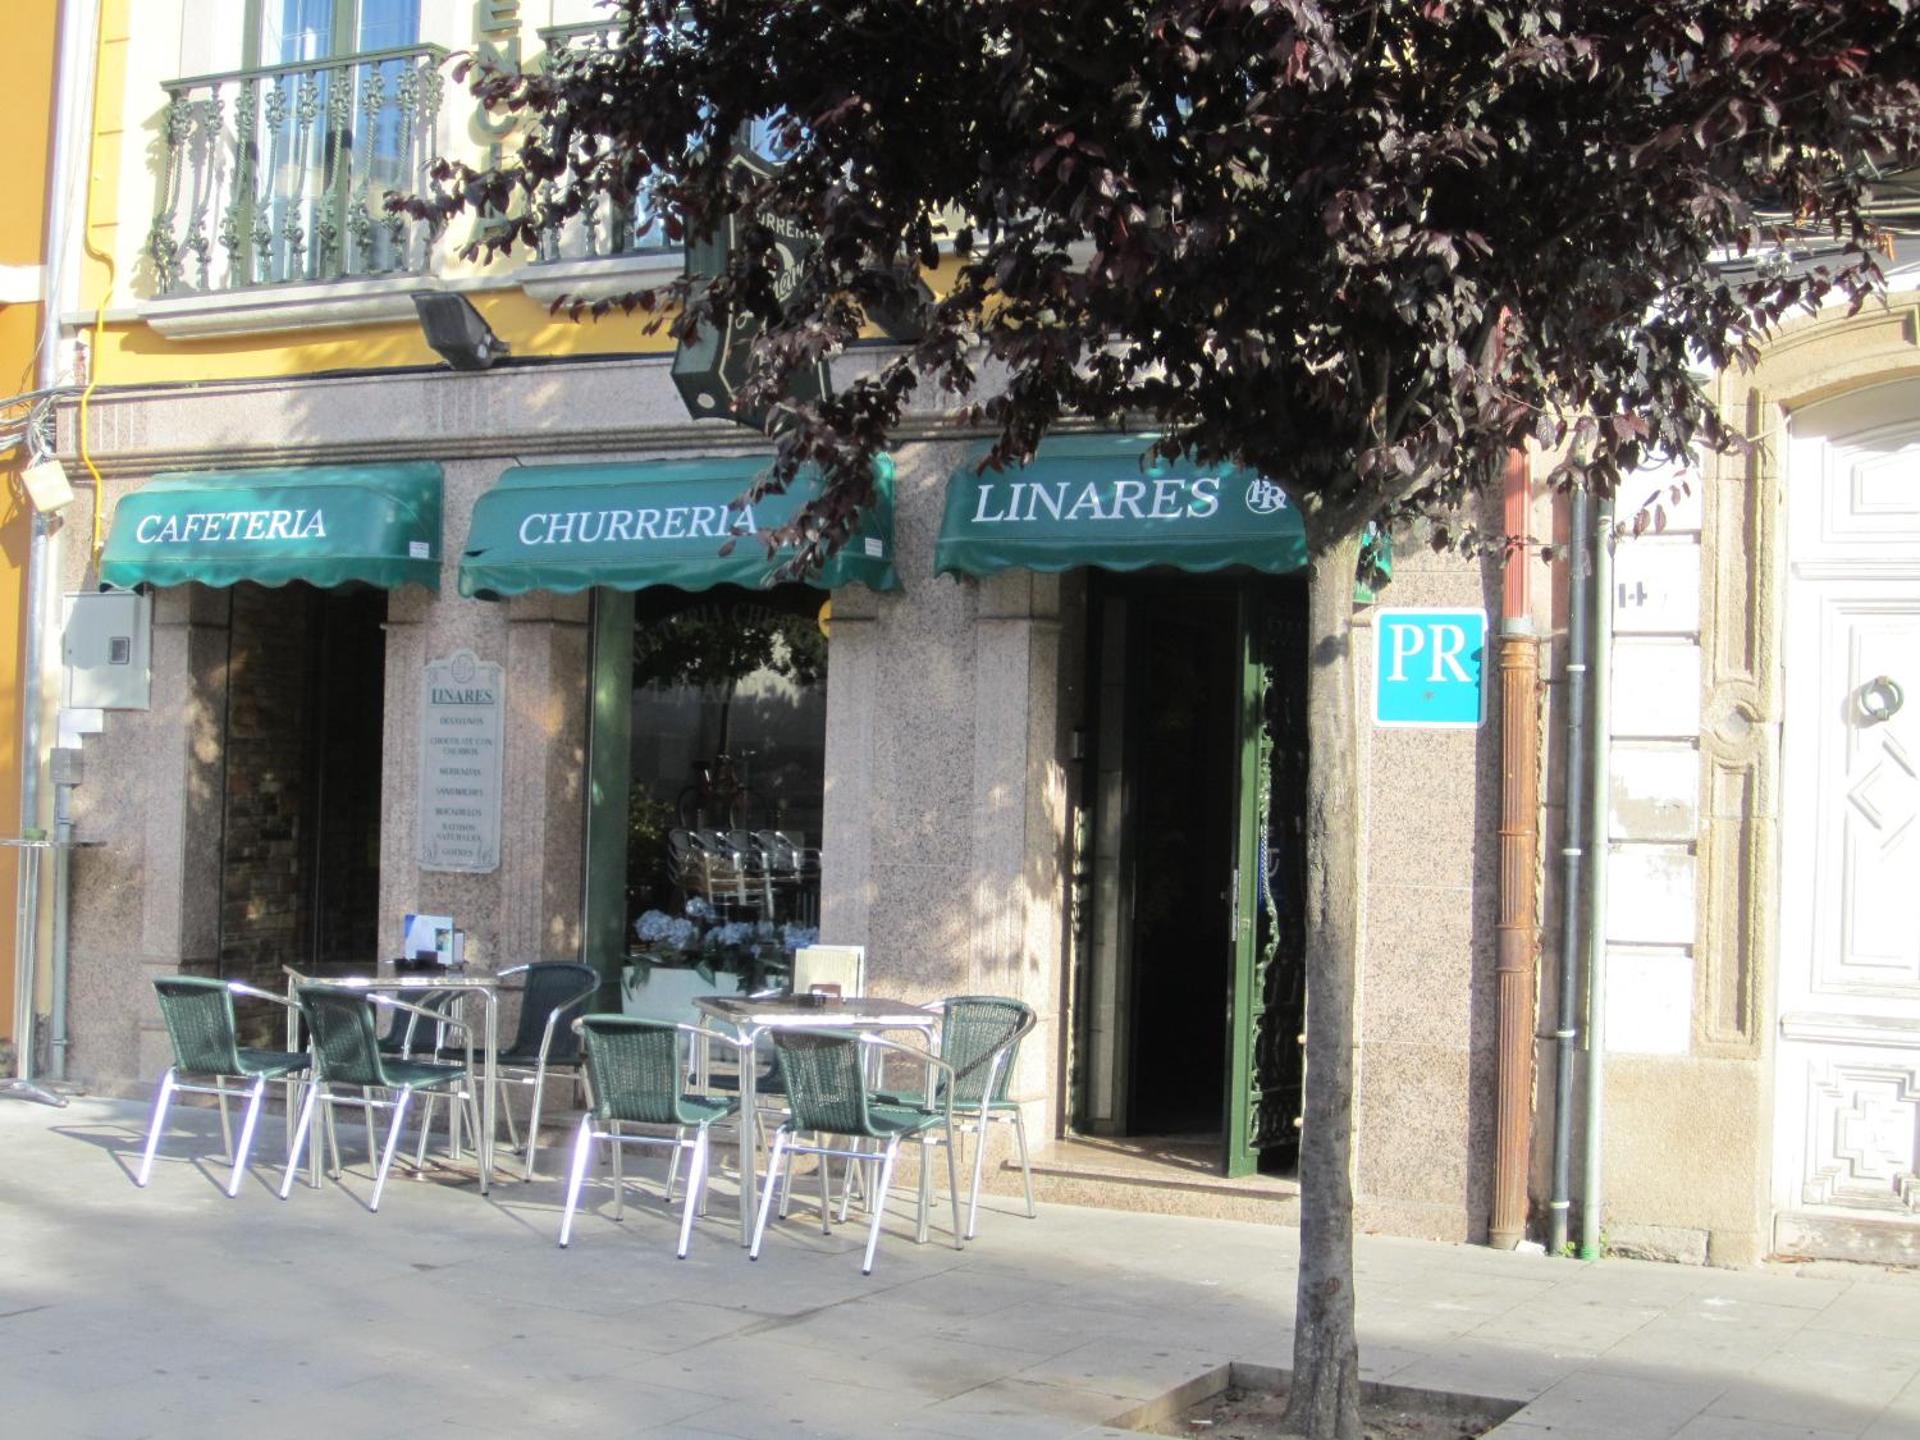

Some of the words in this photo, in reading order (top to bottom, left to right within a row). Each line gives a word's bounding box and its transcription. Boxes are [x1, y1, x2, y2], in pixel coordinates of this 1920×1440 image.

[971, 477, 1220, 522] LINARES
[136, 508, 327, 544] CAFETERIA
[518, 503, 758, 545] CHURRERIA
[1386, 623, 1473, 683] PR
[431, 688, 494, 705] LINARES
